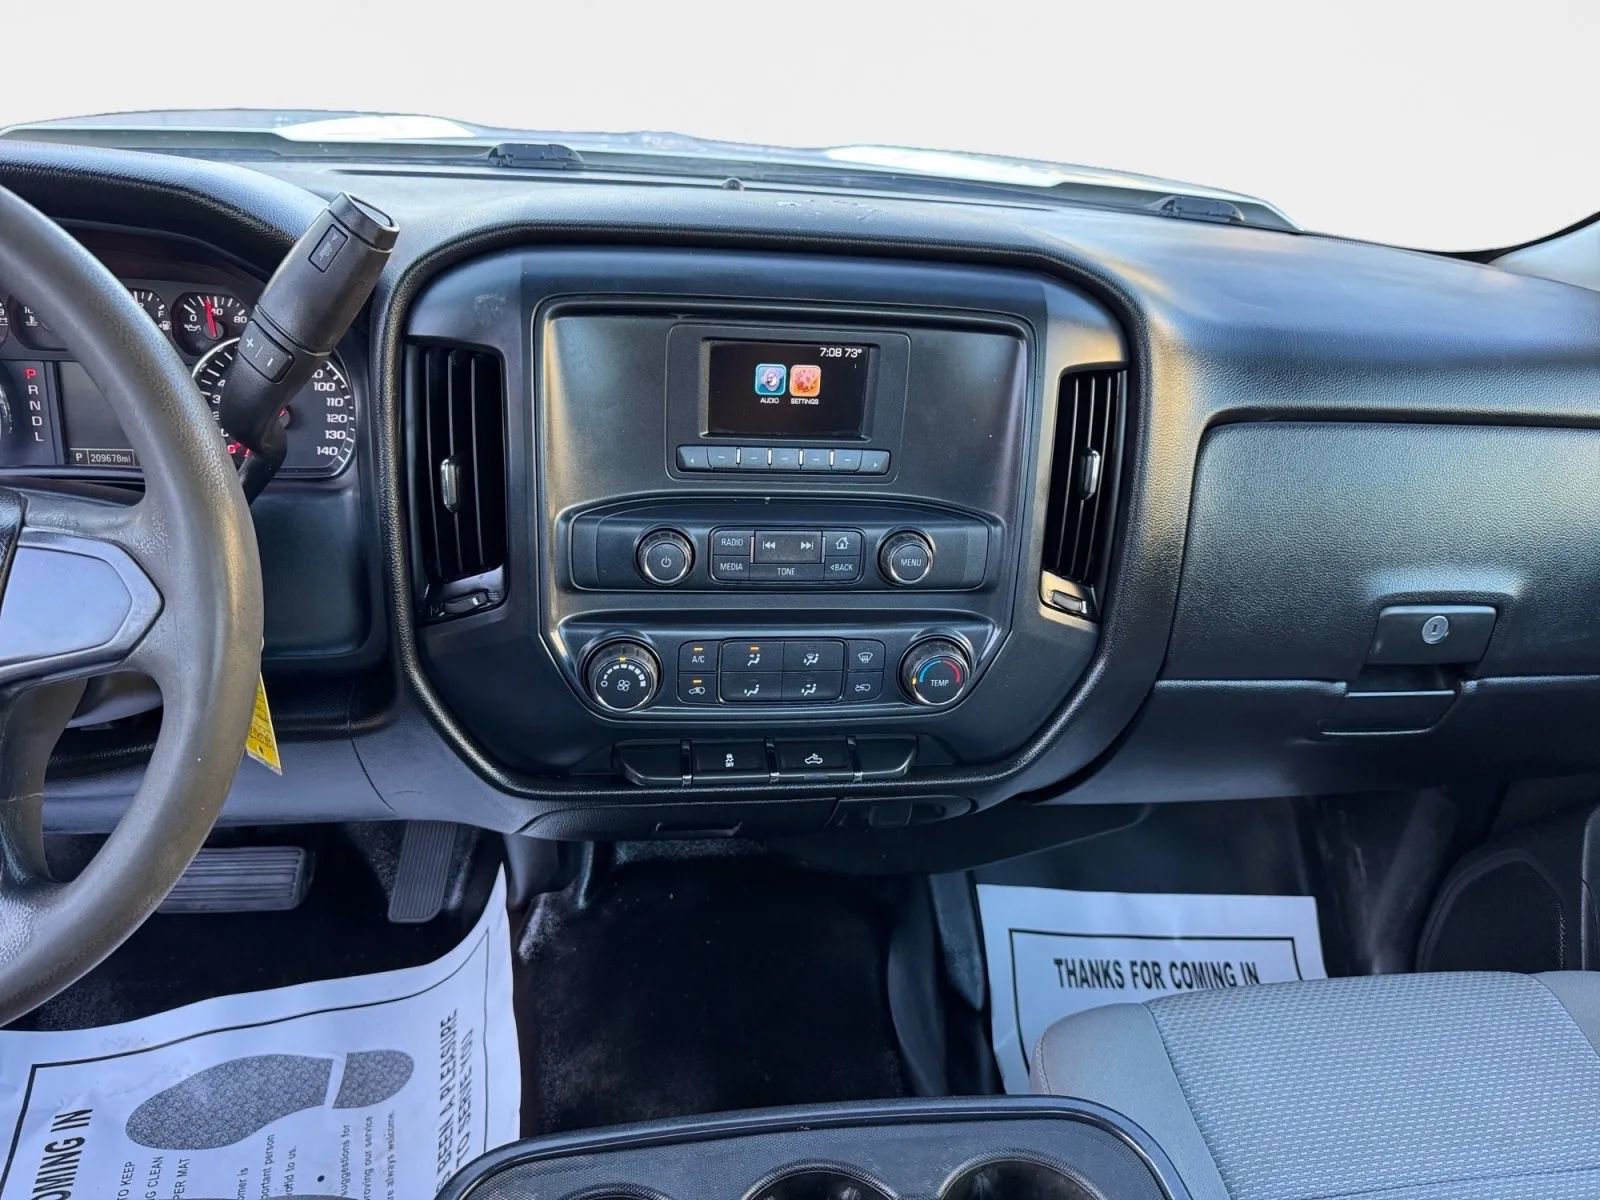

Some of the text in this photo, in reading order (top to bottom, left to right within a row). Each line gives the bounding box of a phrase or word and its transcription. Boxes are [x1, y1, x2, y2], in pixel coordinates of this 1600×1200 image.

[233, 316, 247, 324] 80
[820, 348, 842, 357] 7:08
[25, 368, 37, 380] P
[28, 384, 39, 395] R
[314, 382, 336, 392] 100
[30, 400, 41, 411] N
[326, 397, 344, 407] 110
[32, 416, 43, 427] D
[326, 413, 348, 423] 120
[35, 431, 44, 442] L
[325, 430, 346, 440] 130
[317, 446, 338, 456] 140
[75, 453, 83, 462] P
[721, 538, 744, 547] RADIO
[720, 563, 743, 572] MEDIA
[901, 558, 922, 567] MENU
[777, 567, 795, 576] TONE
[691, 655, 705, 664] A/C
[931, 679, 949, 687] TEMP
[1053, 958, 1261, 989] THANKS FOR COMING IN
[440, 1008, 458, 1101] PLEASURE
[456, 1028, 474, 1169] TO SERVE YOU
[440, 1095, 455, 1117] A
[50, 1108, 93, 1133] IN
[340, 1124, 351, 1138] for
[363, 1115, 373, 1147] service
[265, 1134, 275, 1164] person
[437, 1115, 454, 1175] BEEN
[364, 1151, 373, 1166] our
[147, 1156, 164, 1187] CLEAN
[177, 1157, 190, 1179] MAT
[240, 1167, 249, 1177] is
[286, 1161, 295, 1173] to
[385, 1154, 396, 1187] always
[121, 1161, 136, 1187] KEEP
